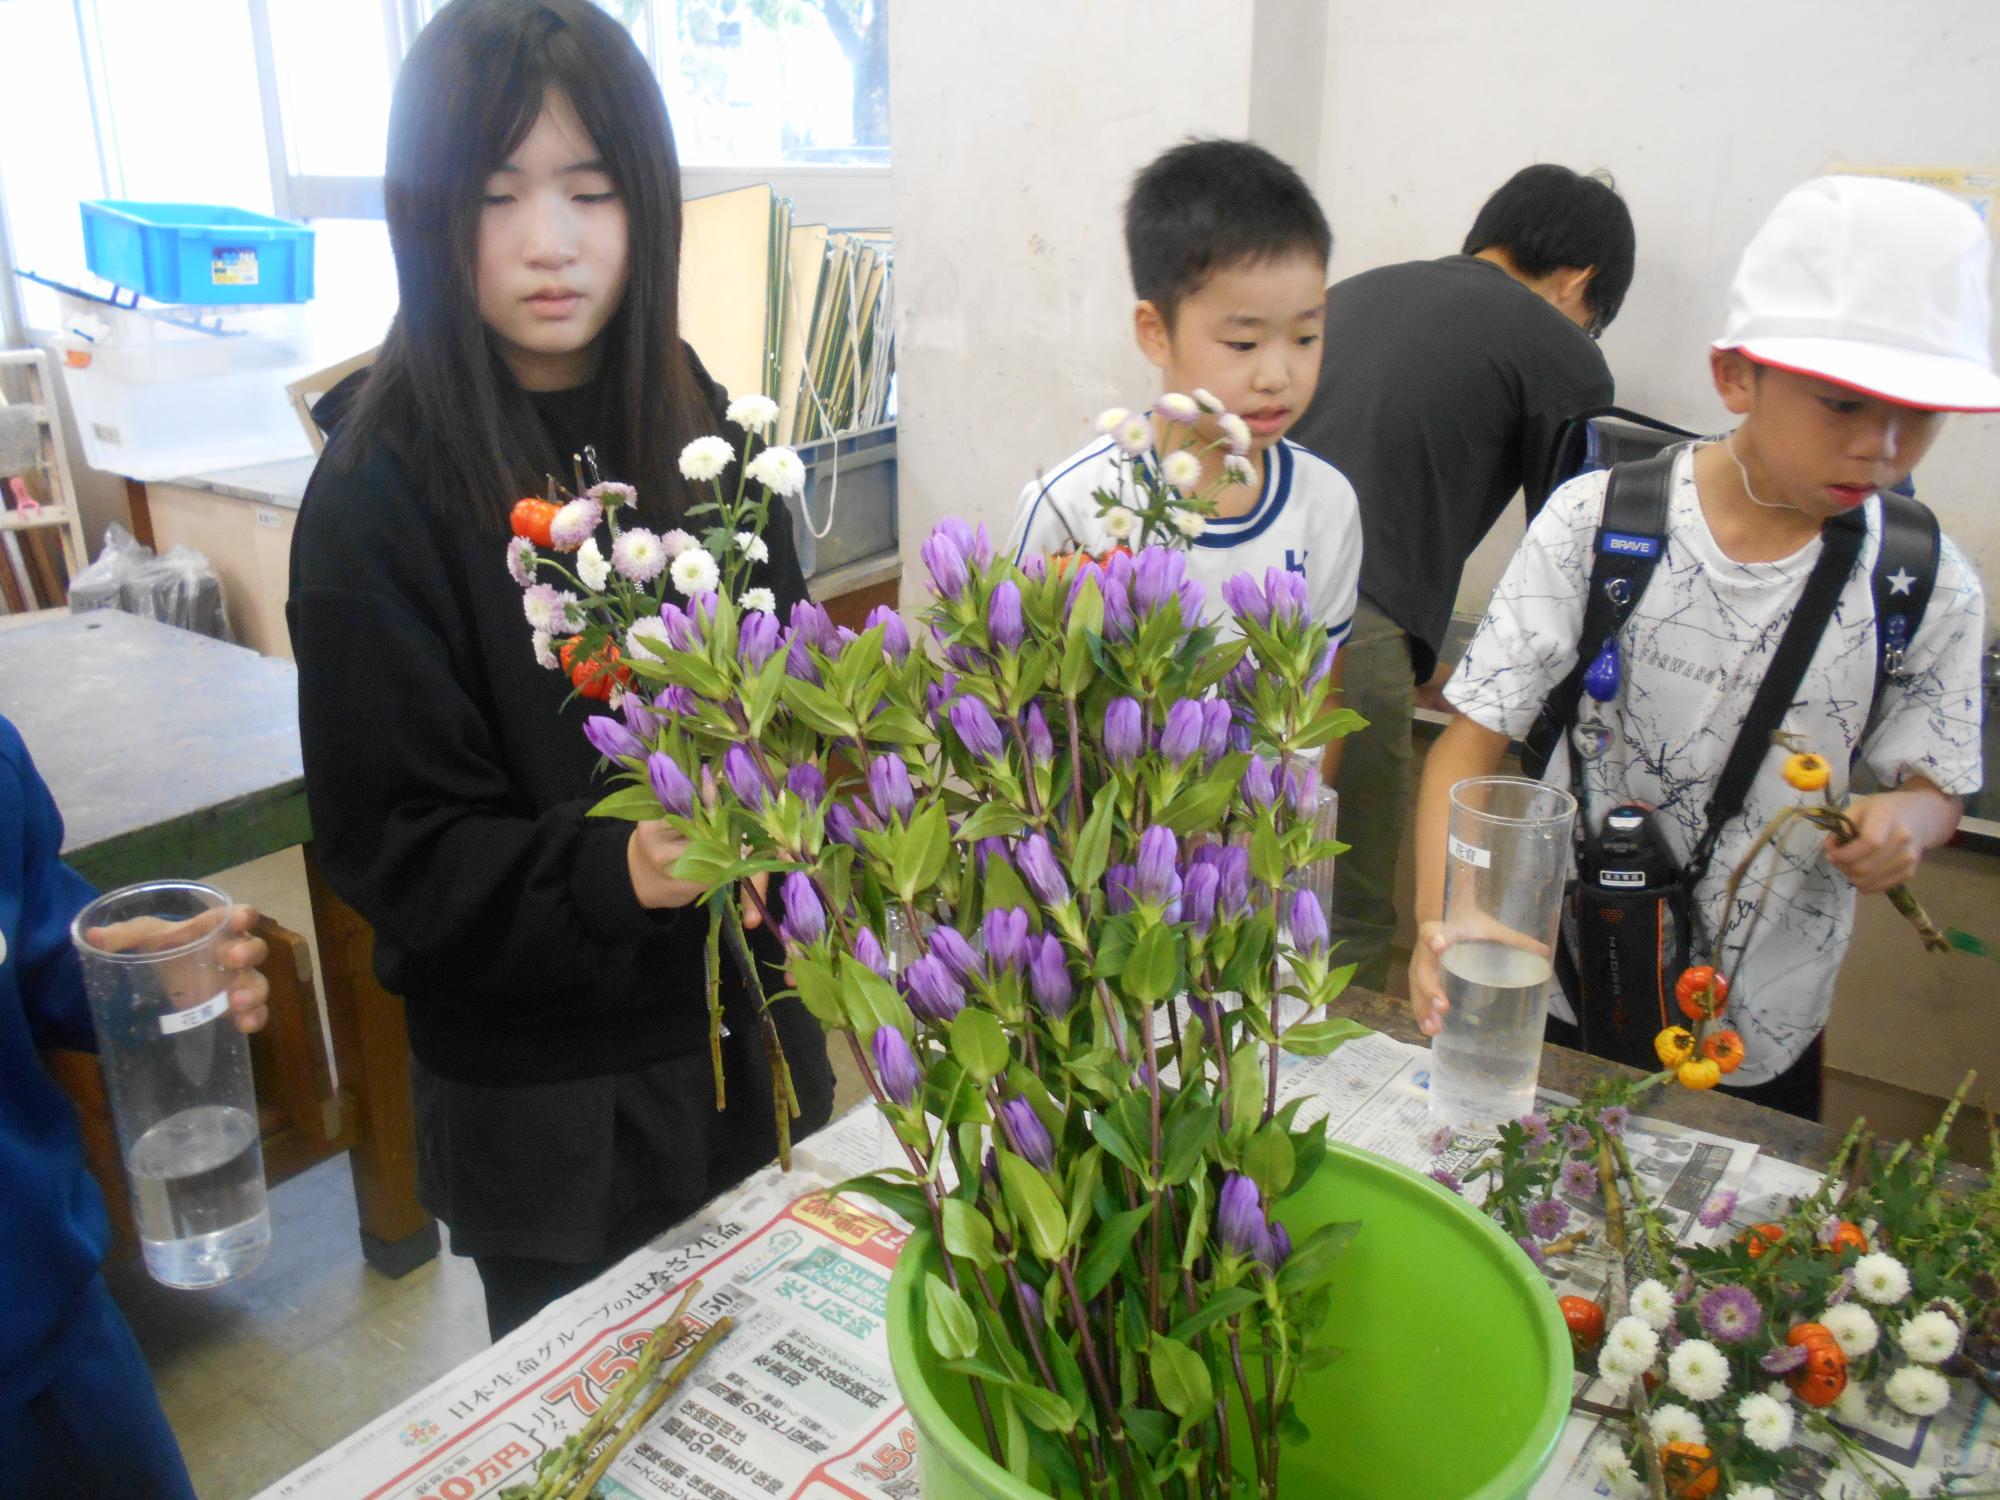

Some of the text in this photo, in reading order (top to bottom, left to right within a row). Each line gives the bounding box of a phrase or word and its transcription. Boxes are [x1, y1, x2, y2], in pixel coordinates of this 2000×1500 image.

[1610, 539, 1650, 553] BRAVE
[1640, 648, 1716, 684] FORWARD
[449, 1221, 743, 1420] 日本生命グループのはなさく生命
[774, 1276, 880, 1340] 死亡保険
[752, 1354, 808, 1388] を実現
[770, 1339, 888, 1410] お手頃な保険料
[679, 1399, 748, 1446] 保険期間は
[707, 1382, 829, 1455] 同額の死亡保障
[418, 1441, 530, 1500] 0万円
[660, 1416, 785, 1496] 最長90歳まで保障
